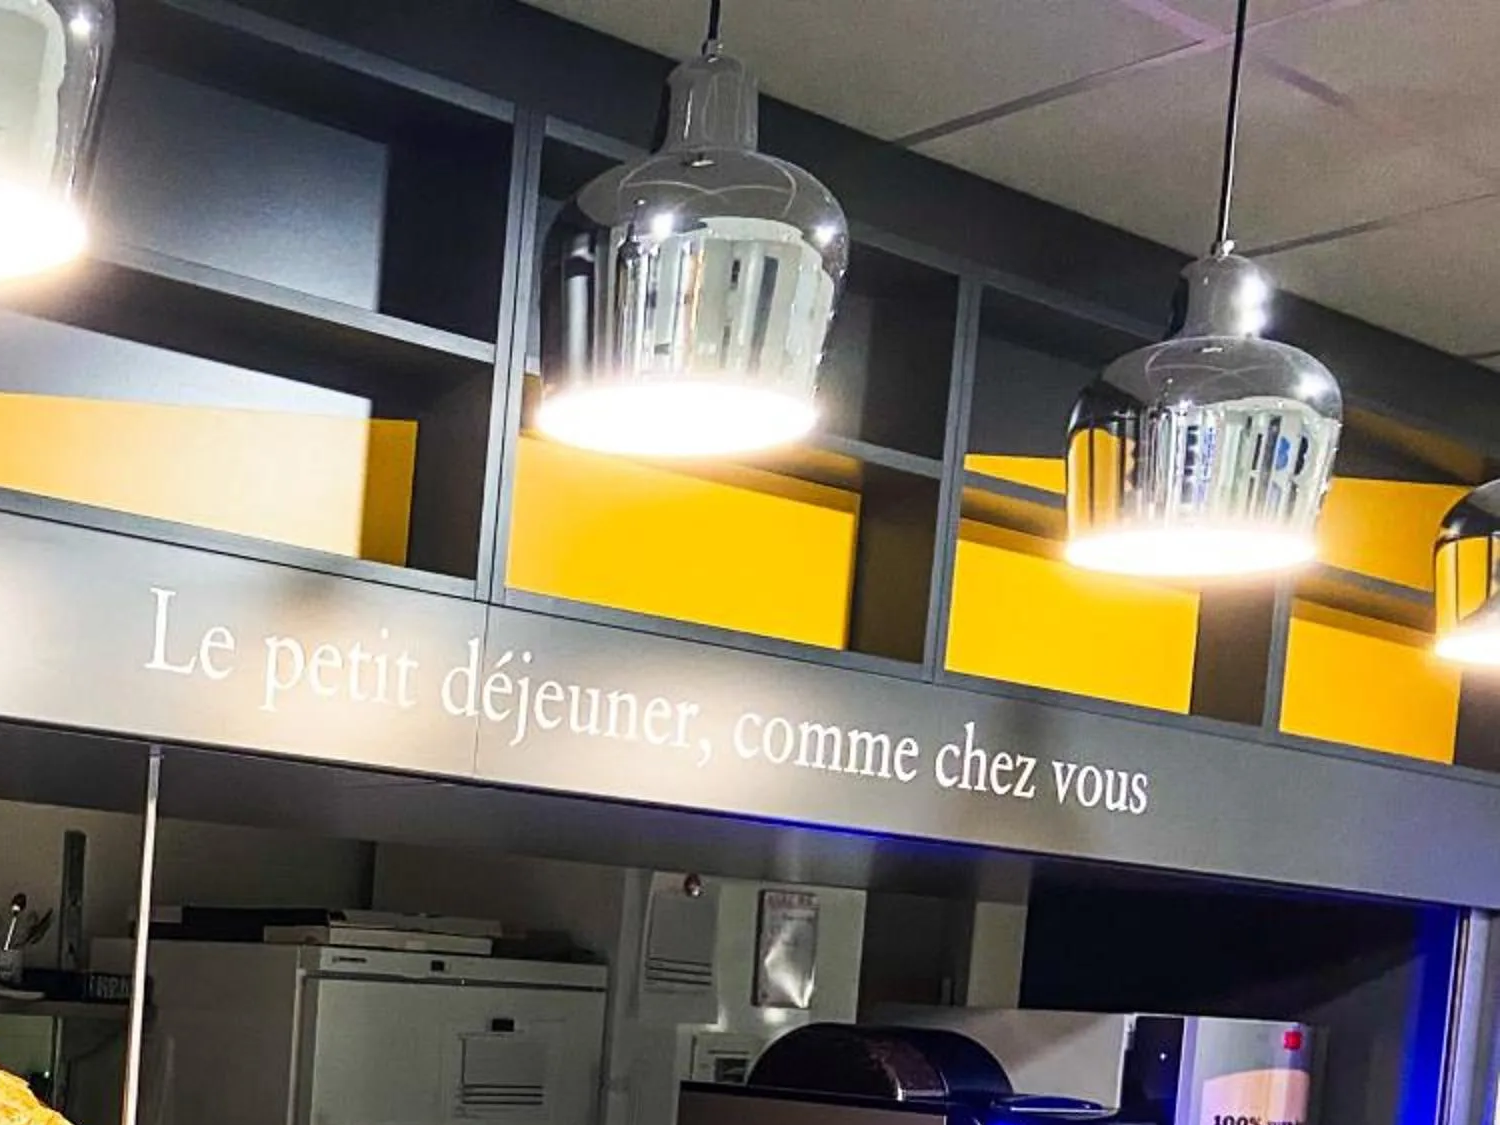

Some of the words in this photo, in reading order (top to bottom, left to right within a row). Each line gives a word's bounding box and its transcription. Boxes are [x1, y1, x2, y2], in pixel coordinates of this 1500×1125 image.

[144, 587, 235, 680] Le
[259, 627, 419, 712] petit
[441, 637, 713, 768] déjeuner,
[733, 713, 919, 782] comme
[934, 721, 1037, 798] chez
[1052, 760, 1149, 814] vous
